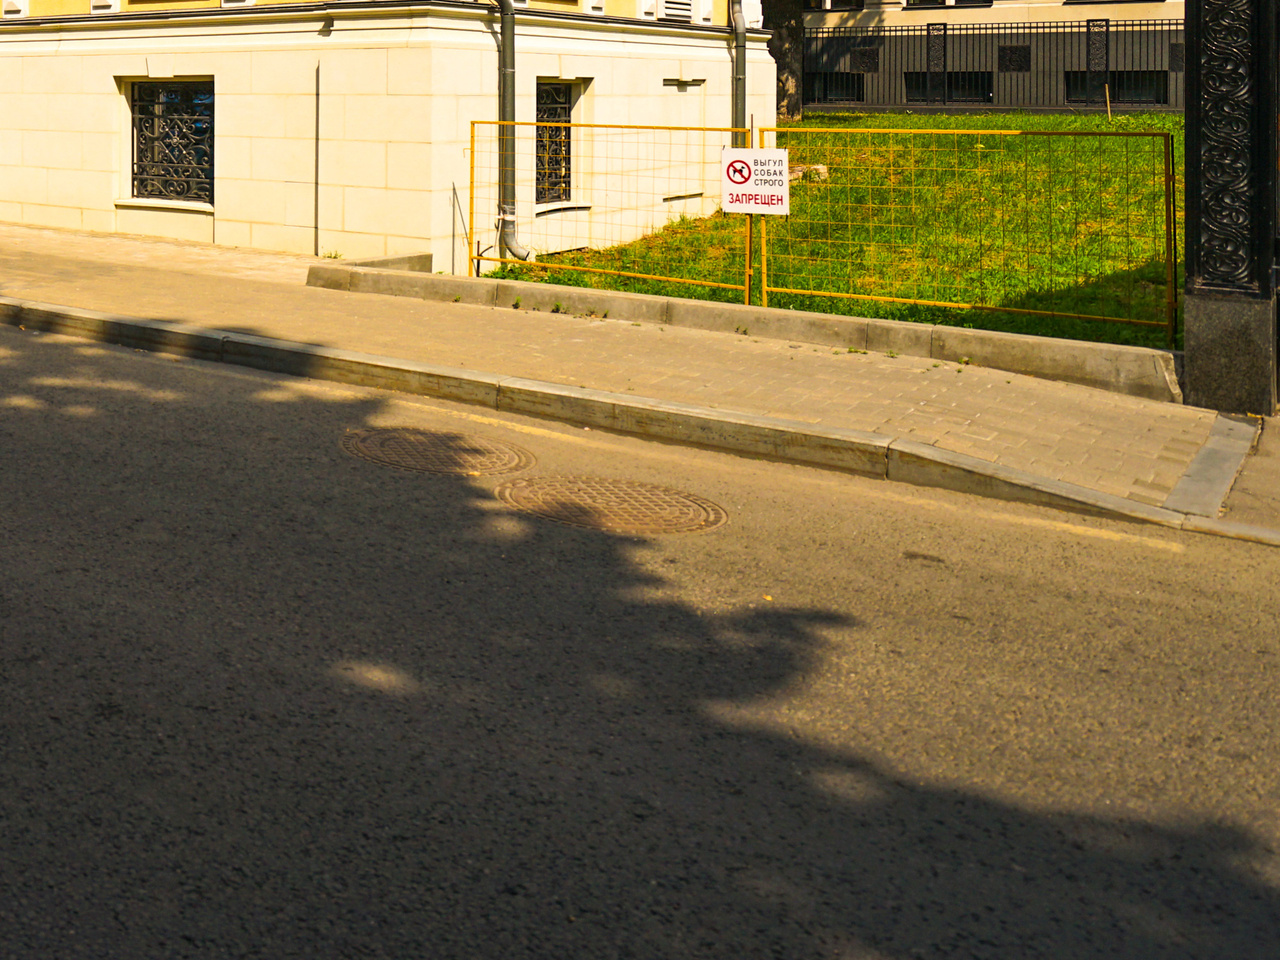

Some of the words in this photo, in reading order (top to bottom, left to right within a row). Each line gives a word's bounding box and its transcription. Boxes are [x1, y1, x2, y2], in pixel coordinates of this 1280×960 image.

[753, 159, 783, 167] ВЫГУЛ
[753, 169, 784, 177] СОБАК
[754, 178, 784, 187] СТРОГО
[728, 192, 784, 207] ЗАПРЕЩЕН
